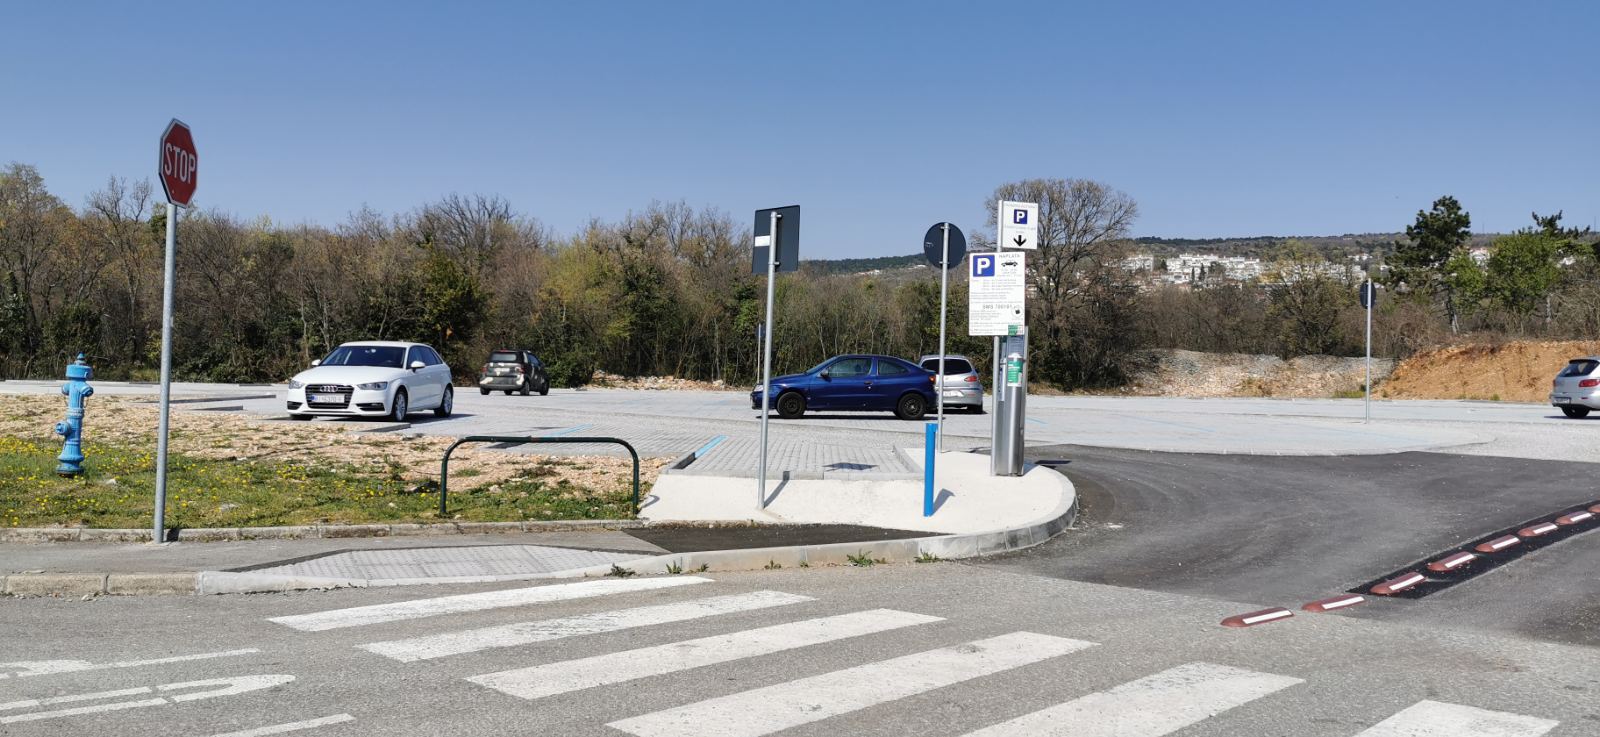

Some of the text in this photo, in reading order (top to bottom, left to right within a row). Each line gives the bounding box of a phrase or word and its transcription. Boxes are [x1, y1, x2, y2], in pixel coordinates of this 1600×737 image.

[164, 142, 196, 184] STOP
[1016, 210, 1026, 223] P
[976, 257, 991, 275] P
